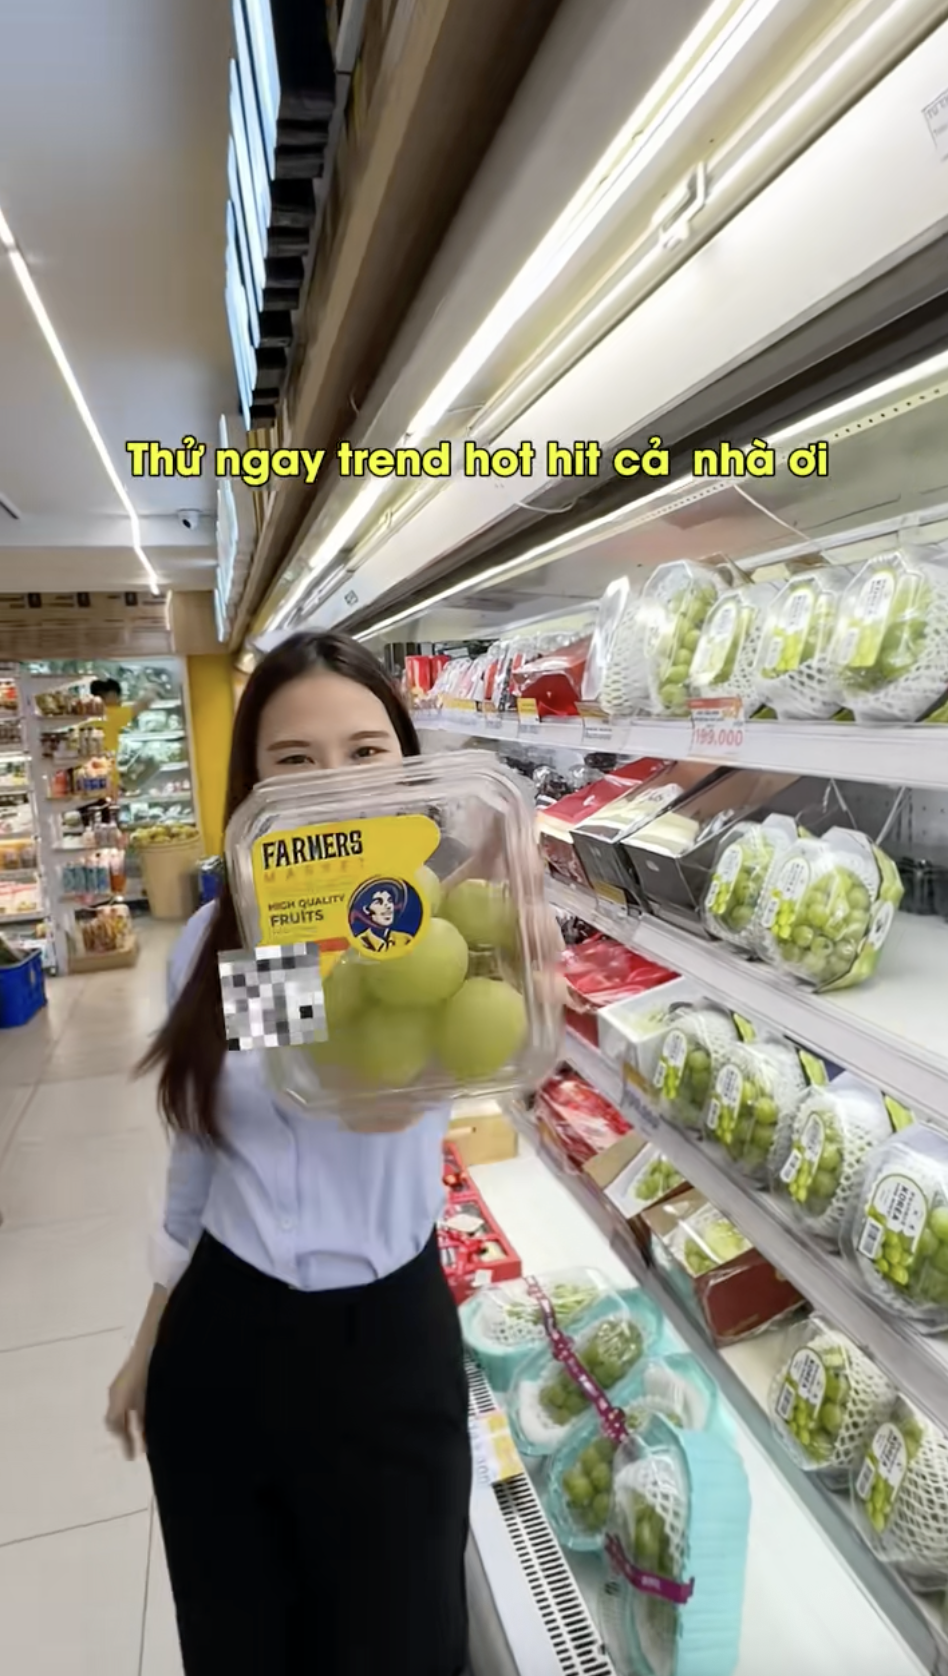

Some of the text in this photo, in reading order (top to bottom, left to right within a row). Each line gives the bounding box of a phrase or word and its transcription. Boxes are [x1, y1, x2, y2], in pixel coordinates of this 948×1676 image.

[262, 830, 363, 869] FARMERS
[268, 893, 345, 911] HIGH QUALITY
[270, 909, 324, 927] FRUITS
